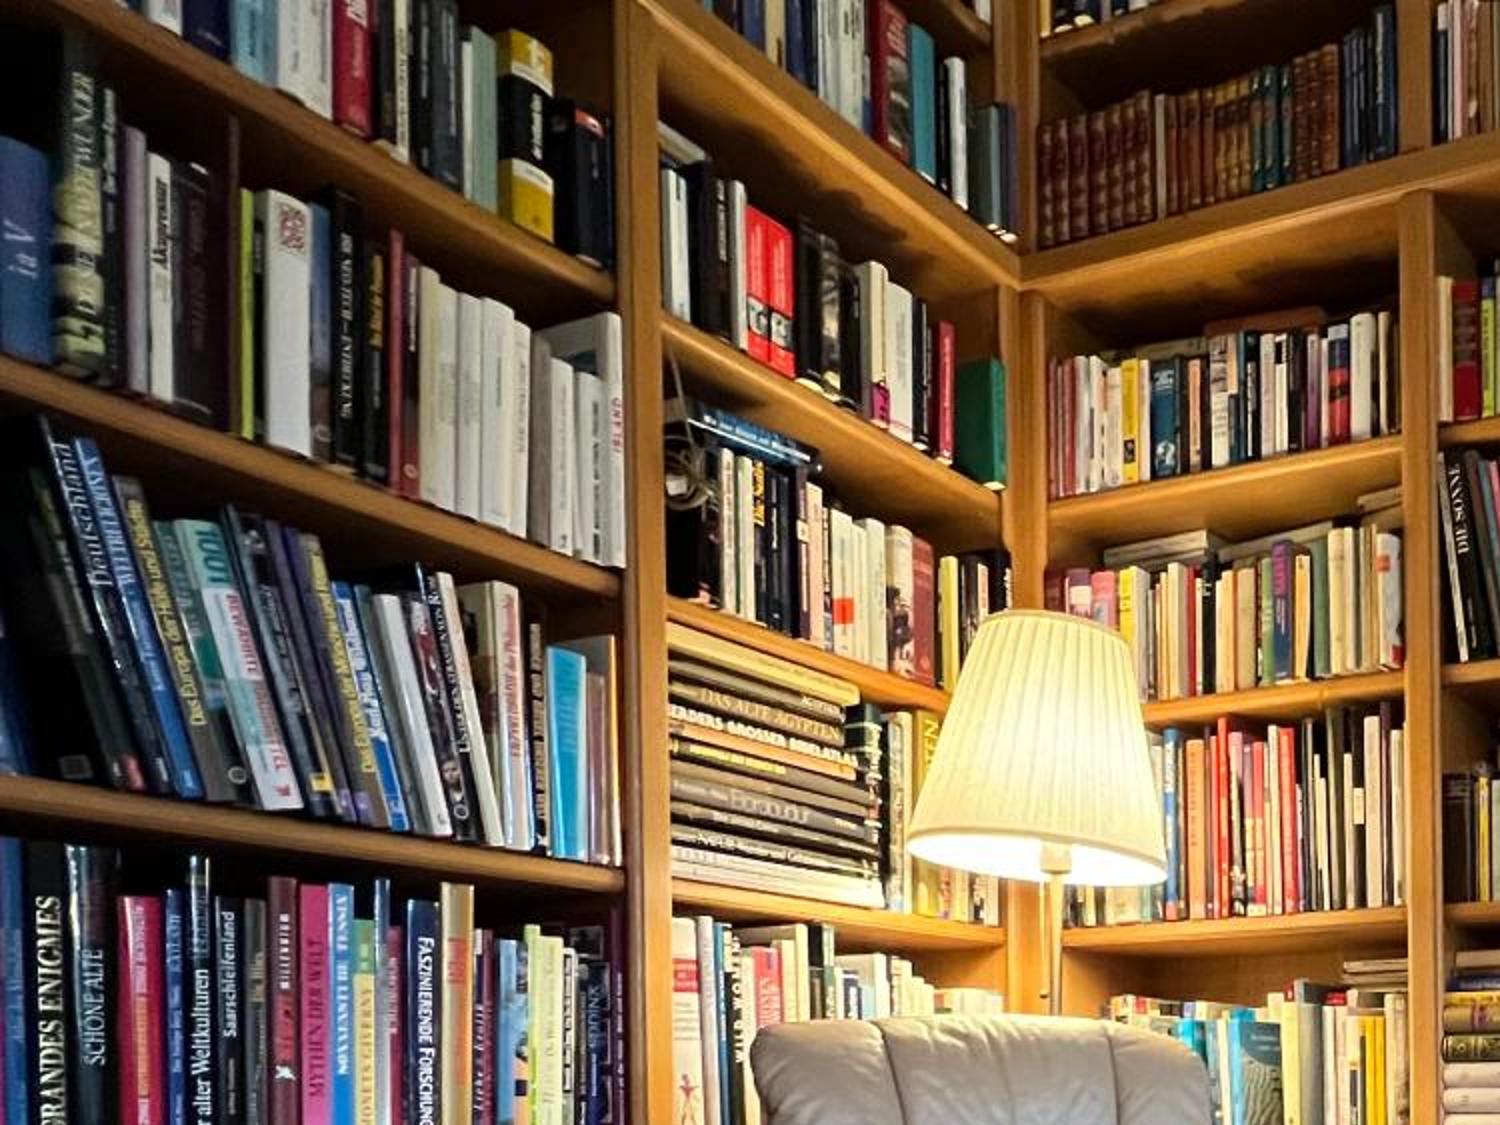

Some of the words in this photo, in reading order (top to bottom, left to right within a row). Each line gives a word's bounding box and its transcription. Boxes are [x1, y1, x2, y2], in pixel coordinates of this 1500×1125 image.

[53, 441, 114, 587] Deutschland
[1448, 463, 1465, 522] SONNE
[198, 528, 231, 585] 1001
[1455, 523, 1471, 554] DIE
[173, 647, 202, 696] Europa
[34, 895, 63, 1012] ENIGMES
[81, 949, 105, 990] ALTE
[221, 911, 237, 1038] Saarschleifenland
[305, 938, 322, 983] WELT
[306, 985, 324, 1020] DER
[417, 937, 435, 1042] FASZINIERENDE
[190, 969, 211, 1075] Weltkulturen
[307, 1025, 325, 1098] MYTHEN
[192, 1079, 211, 1116] alter
